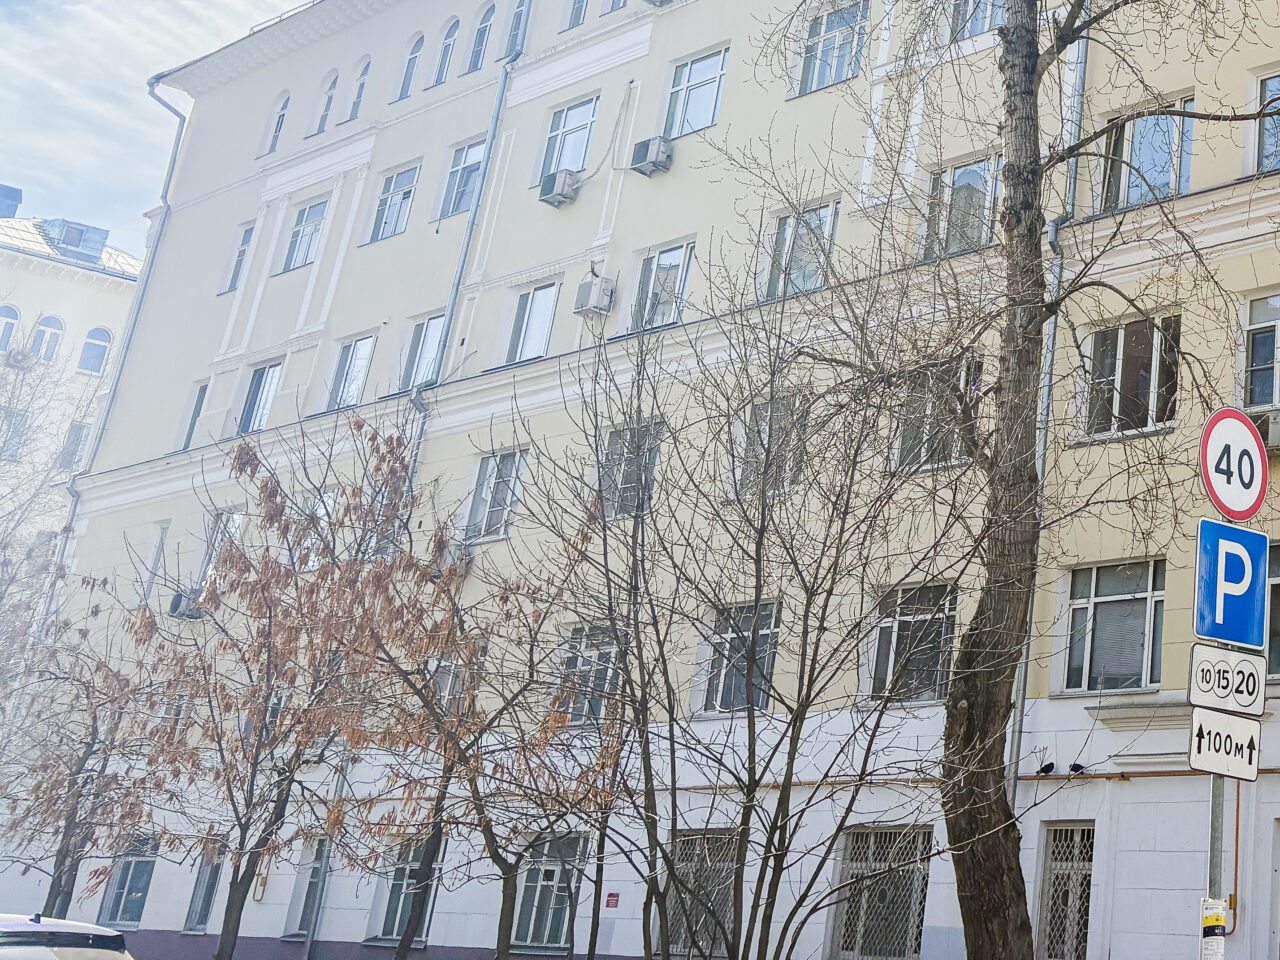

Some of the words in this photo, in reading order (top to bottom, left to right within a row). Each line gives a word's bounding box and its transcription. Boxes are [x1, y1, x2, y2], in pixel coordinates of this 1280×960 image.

[1214, 443, 1255, 490] 40
[1215, 538, 1253, 625] P
[1200, 668, 1212, 684] 10
[1216, 668, 1230, 690] 15
[1235, 670, 1256, 696] 20
